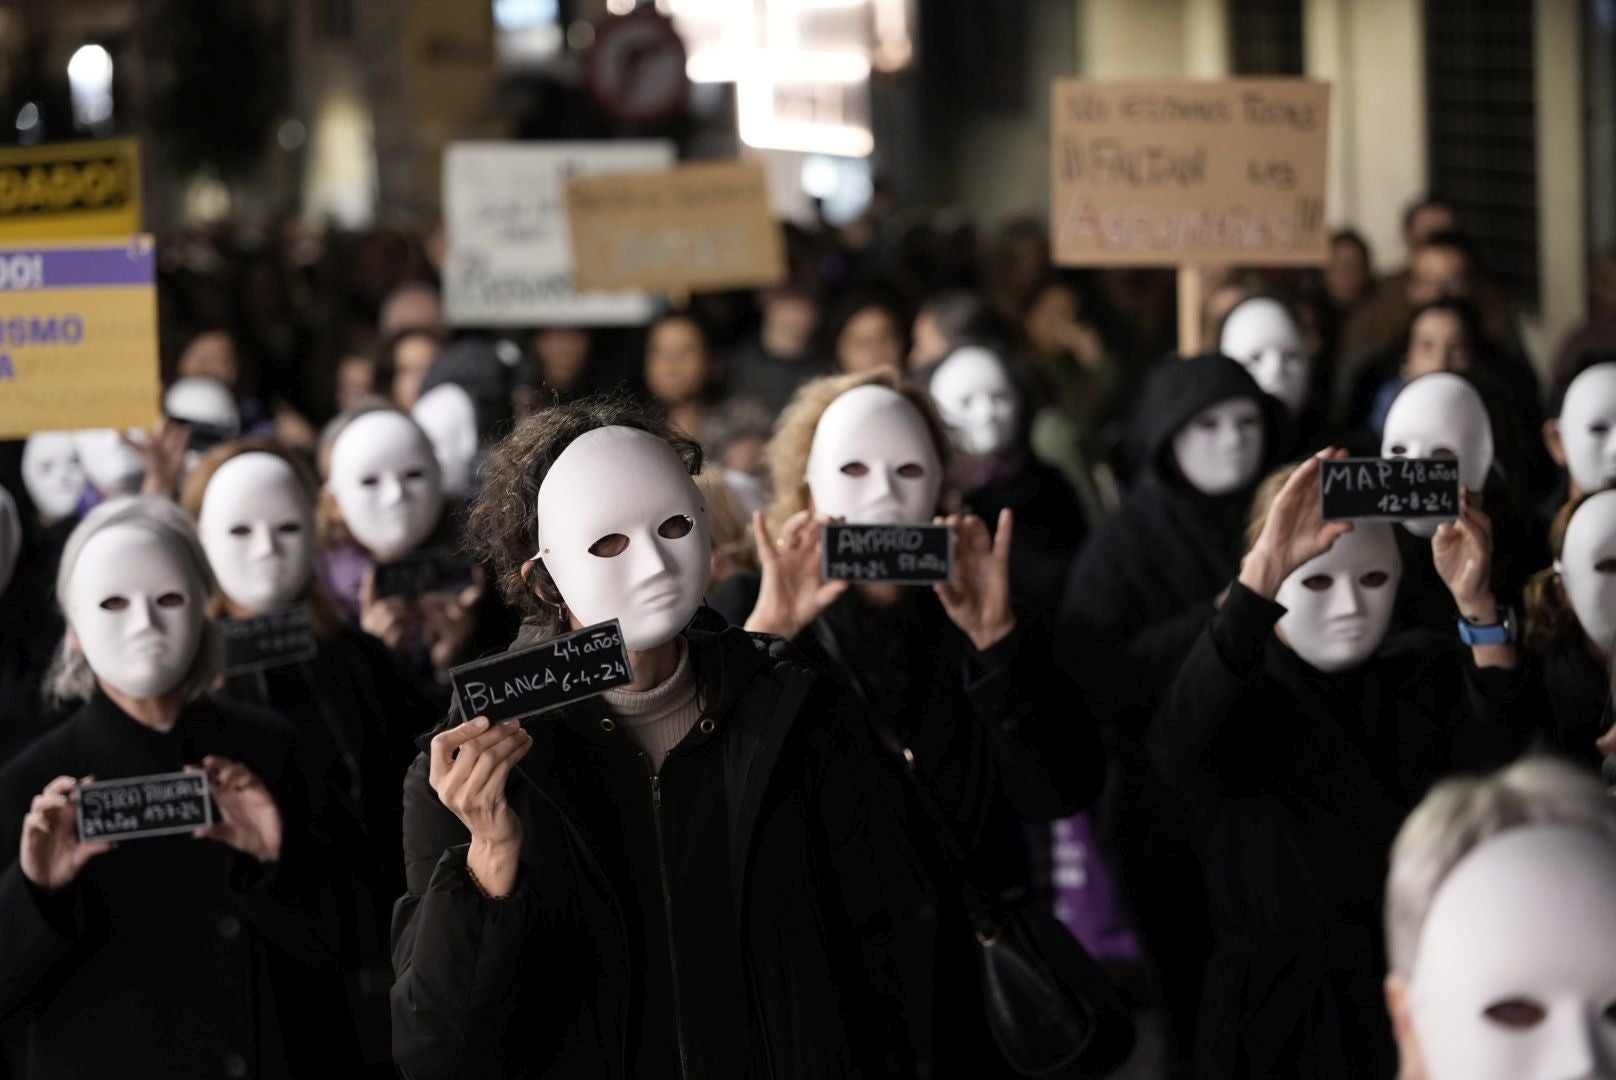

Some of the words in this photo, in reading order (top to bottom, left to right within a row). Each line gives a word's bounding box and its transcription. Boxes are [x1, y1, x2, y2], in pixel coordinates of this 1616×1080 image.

[1401, 461, 1426, 485] 48
[1377, 491, 1453, 513] 12-8-24
[553, 640, 581, 661] 44
[583, 632, 621, 653] años
[464, 667, 557, 714] BLANCA
[562, 661, 626, 692] 6-4-24
